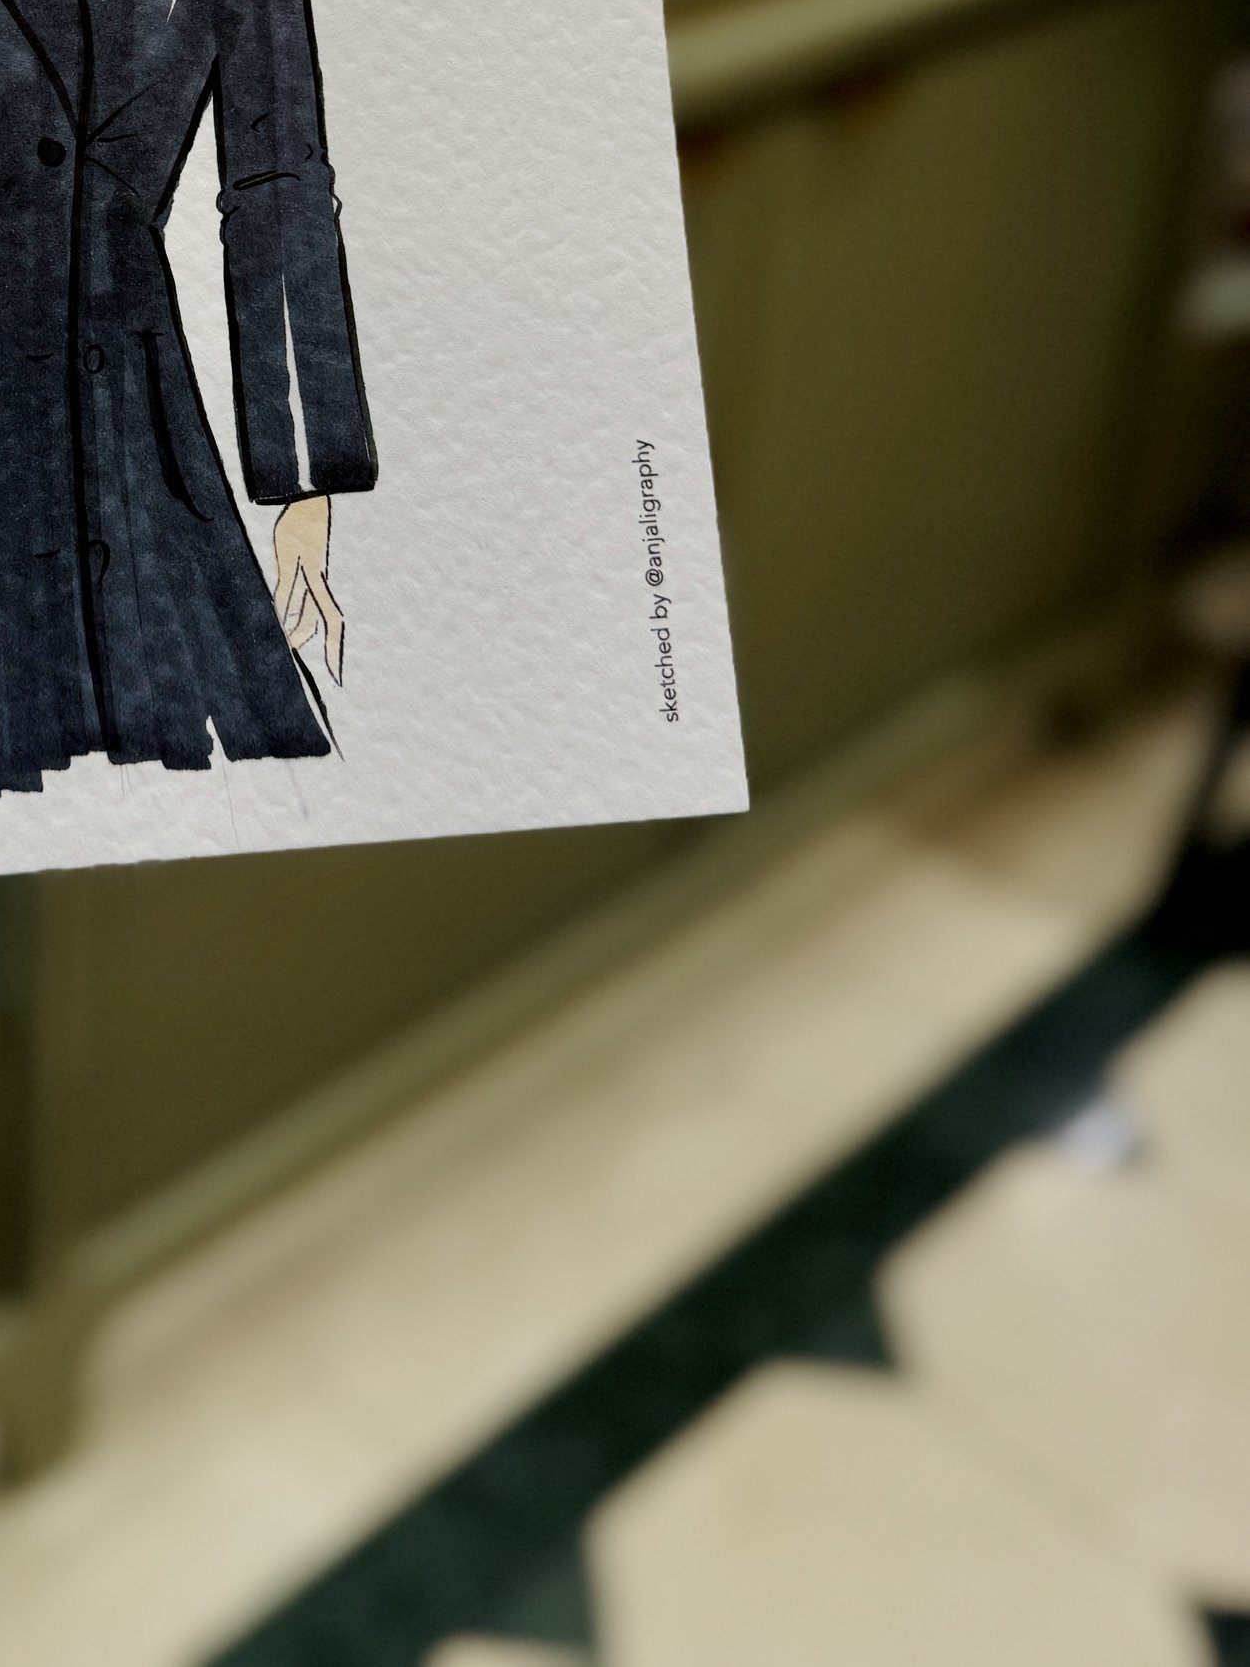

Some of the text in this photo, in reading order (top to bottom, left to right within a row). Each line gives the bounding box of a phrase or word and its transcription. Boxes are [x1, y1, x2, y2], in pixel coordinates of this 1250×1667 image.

[631, 439, 680, 724] sketched by @anjaligraphy
